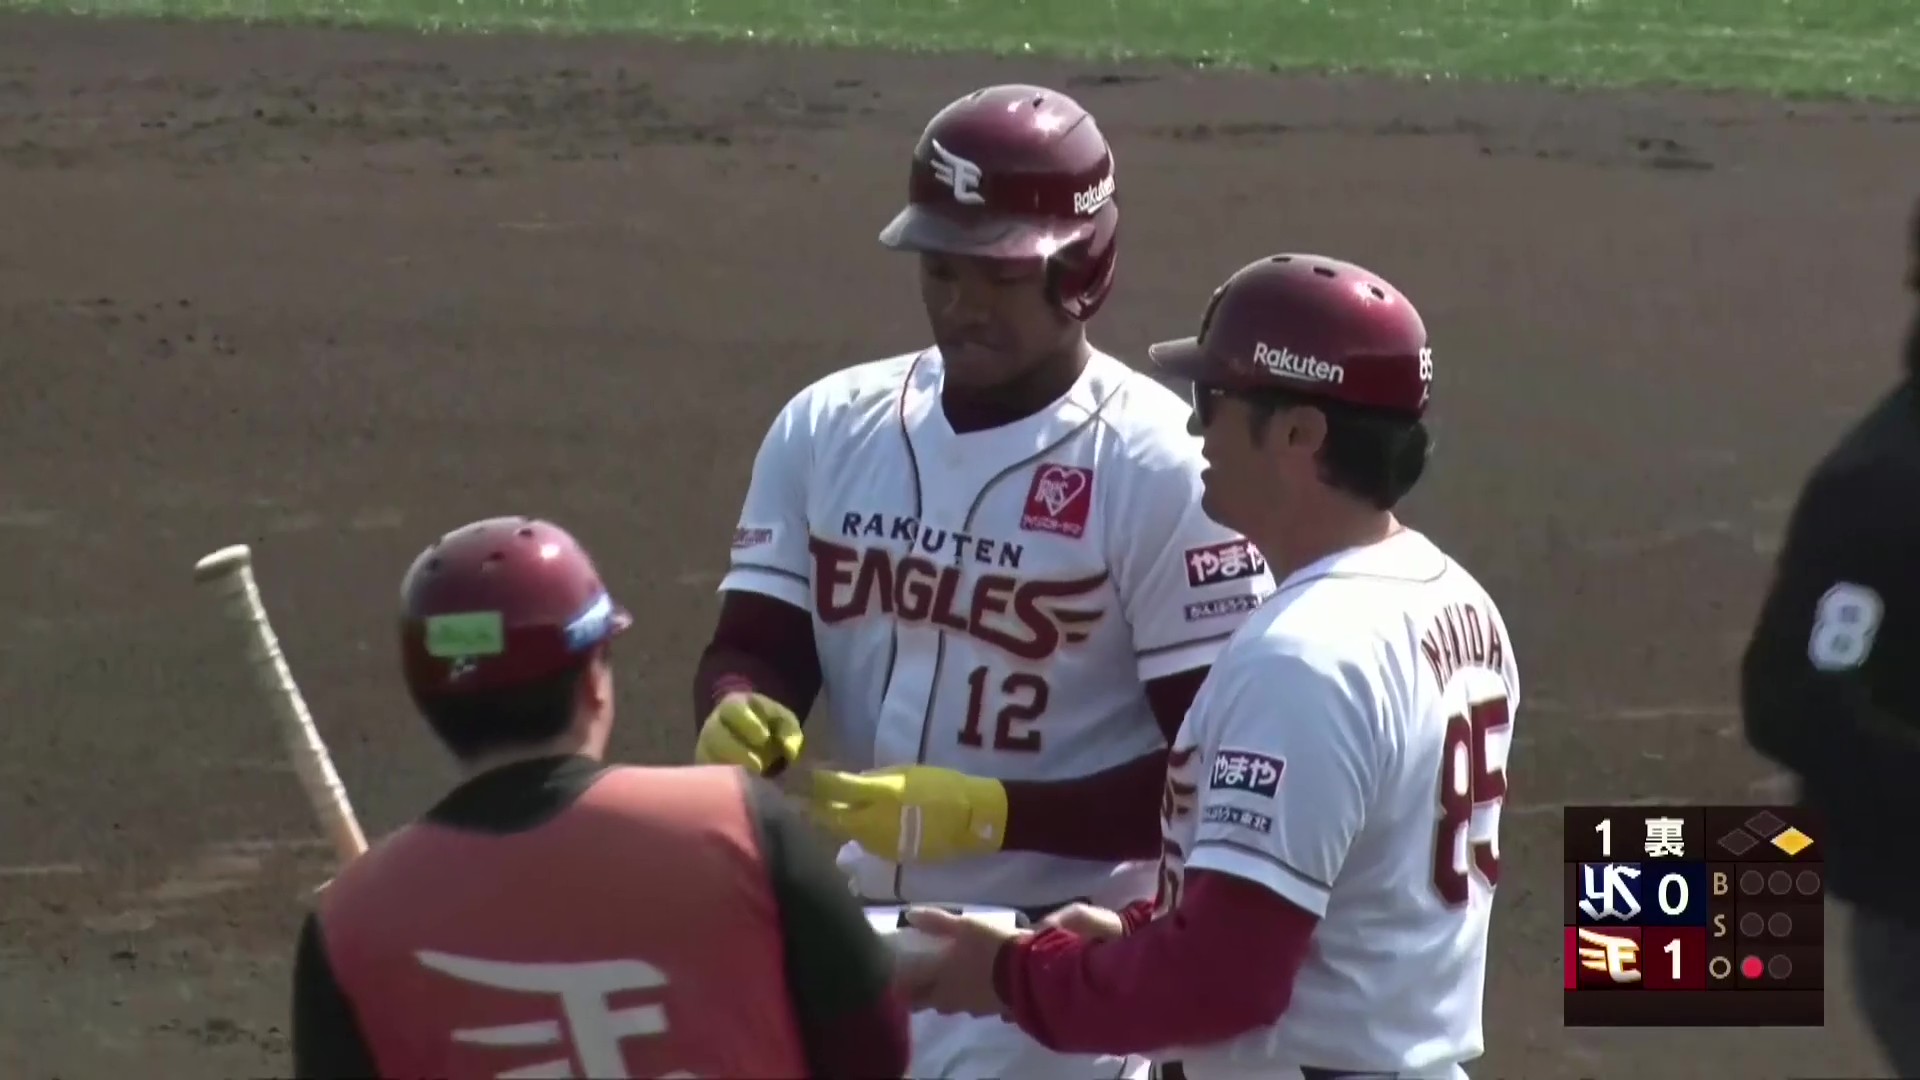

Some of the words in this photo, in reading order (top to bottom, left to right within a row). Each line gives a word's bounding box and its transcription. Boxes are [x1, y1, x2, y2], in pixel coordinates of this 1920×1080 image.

[1253, 341, 1345, 384] Rakuten
[1418, 347, 1433, 382] 85
[841, 511, 1024, 568] RAKUTEN
[1190, 541, 1264, 583] やまや
[808, 534, 1109, 660] EAGLES
[1808, 581, 1885, 671] 8
[957, 665, 1049, 752] 12
[1213, 754, 1278, 789] やまや
[1432, 694, 1510, 908] 85
